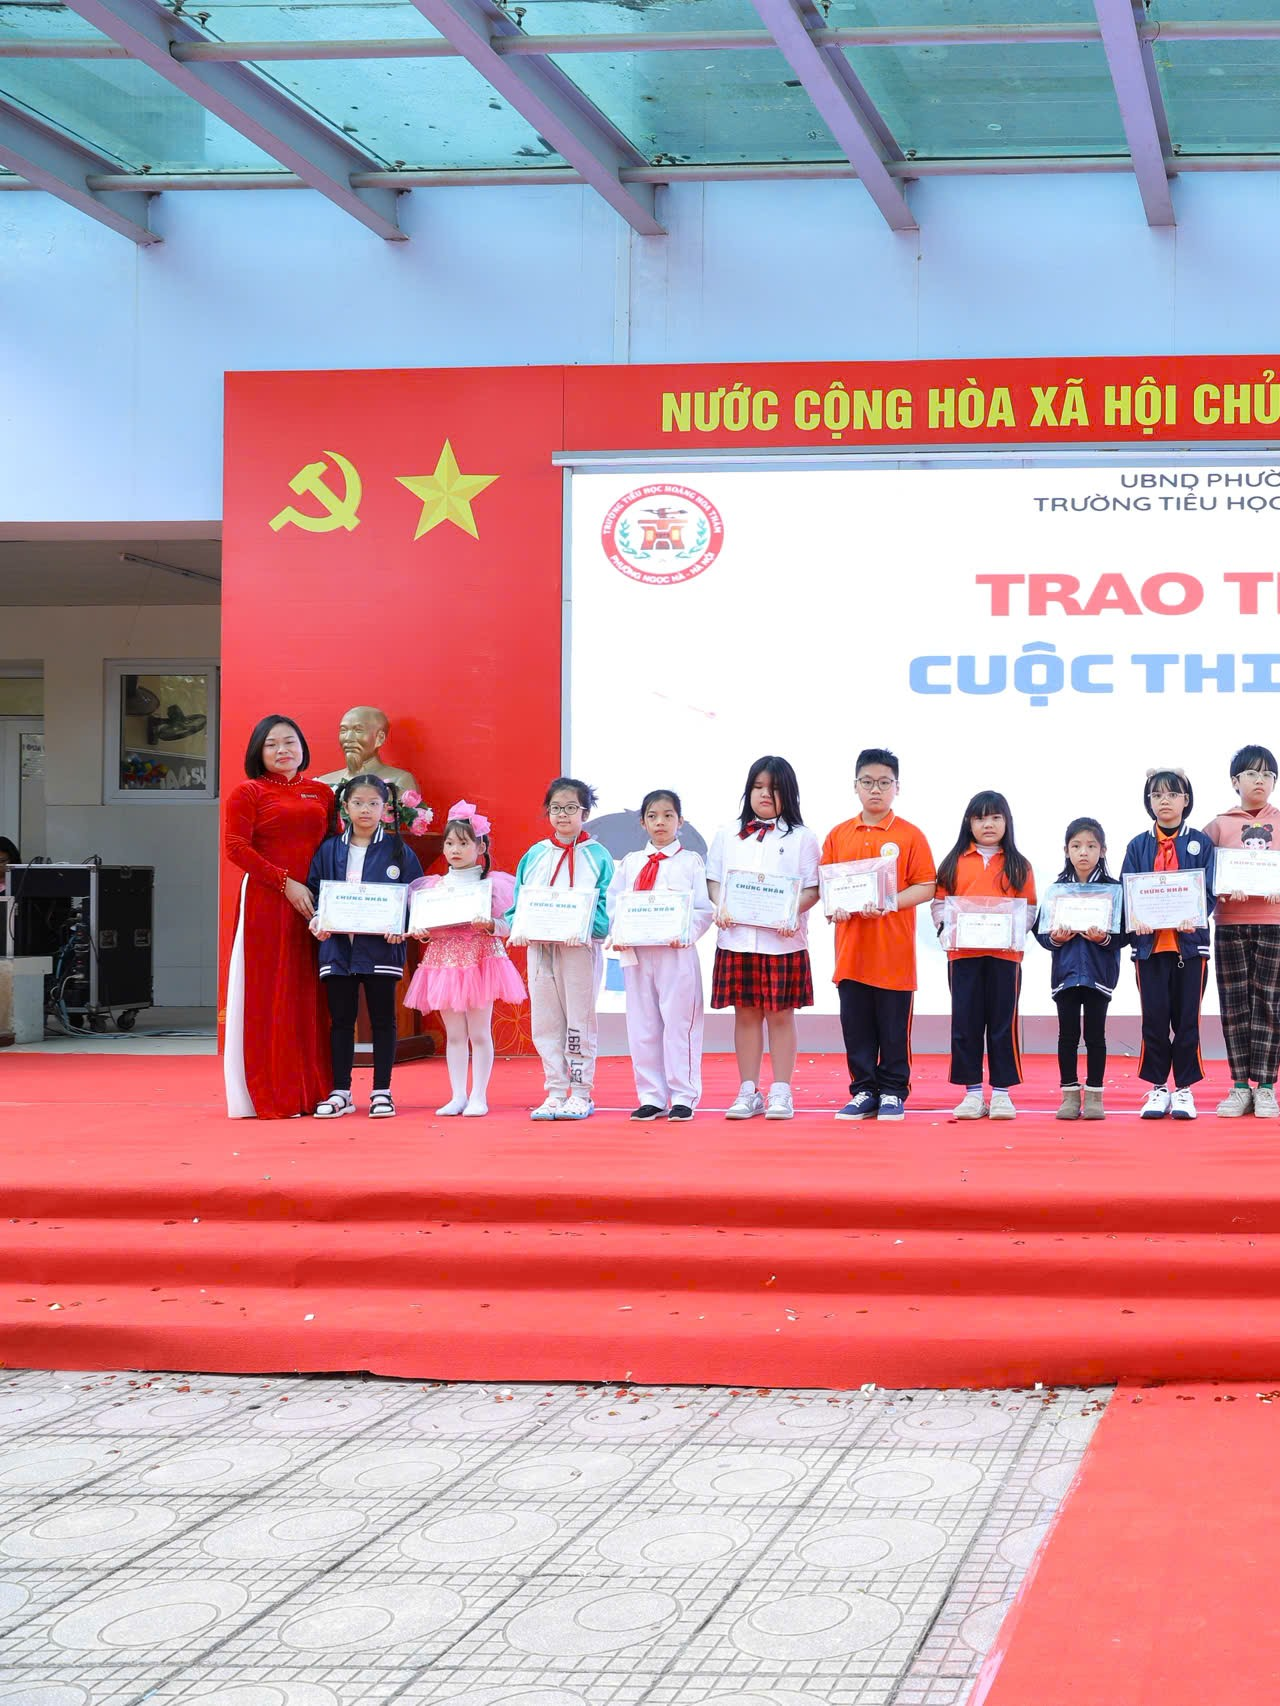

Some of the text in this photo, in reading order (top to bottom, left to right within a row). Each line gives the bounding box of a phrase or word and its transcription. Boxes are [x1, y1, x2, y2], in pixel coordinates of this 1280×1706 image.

[662, 383, 779, 432] NƯỚC
[794, 382, 912, 440] CỘNG
[928, 378, 1015, 428] HÒA
[1030, 377, 1088, 427] XÃ
[1104, 377, 1177, 435] HỘI
[1033, 492, 1151, 511] TRƯỜNG
[1159, 488, 1216, 511] TIỂU
[1120, 473, 1199, 488] UBND
[975, 572, 1204, 616] TRAO
[909, 641, 1113, 707] CUỘC
